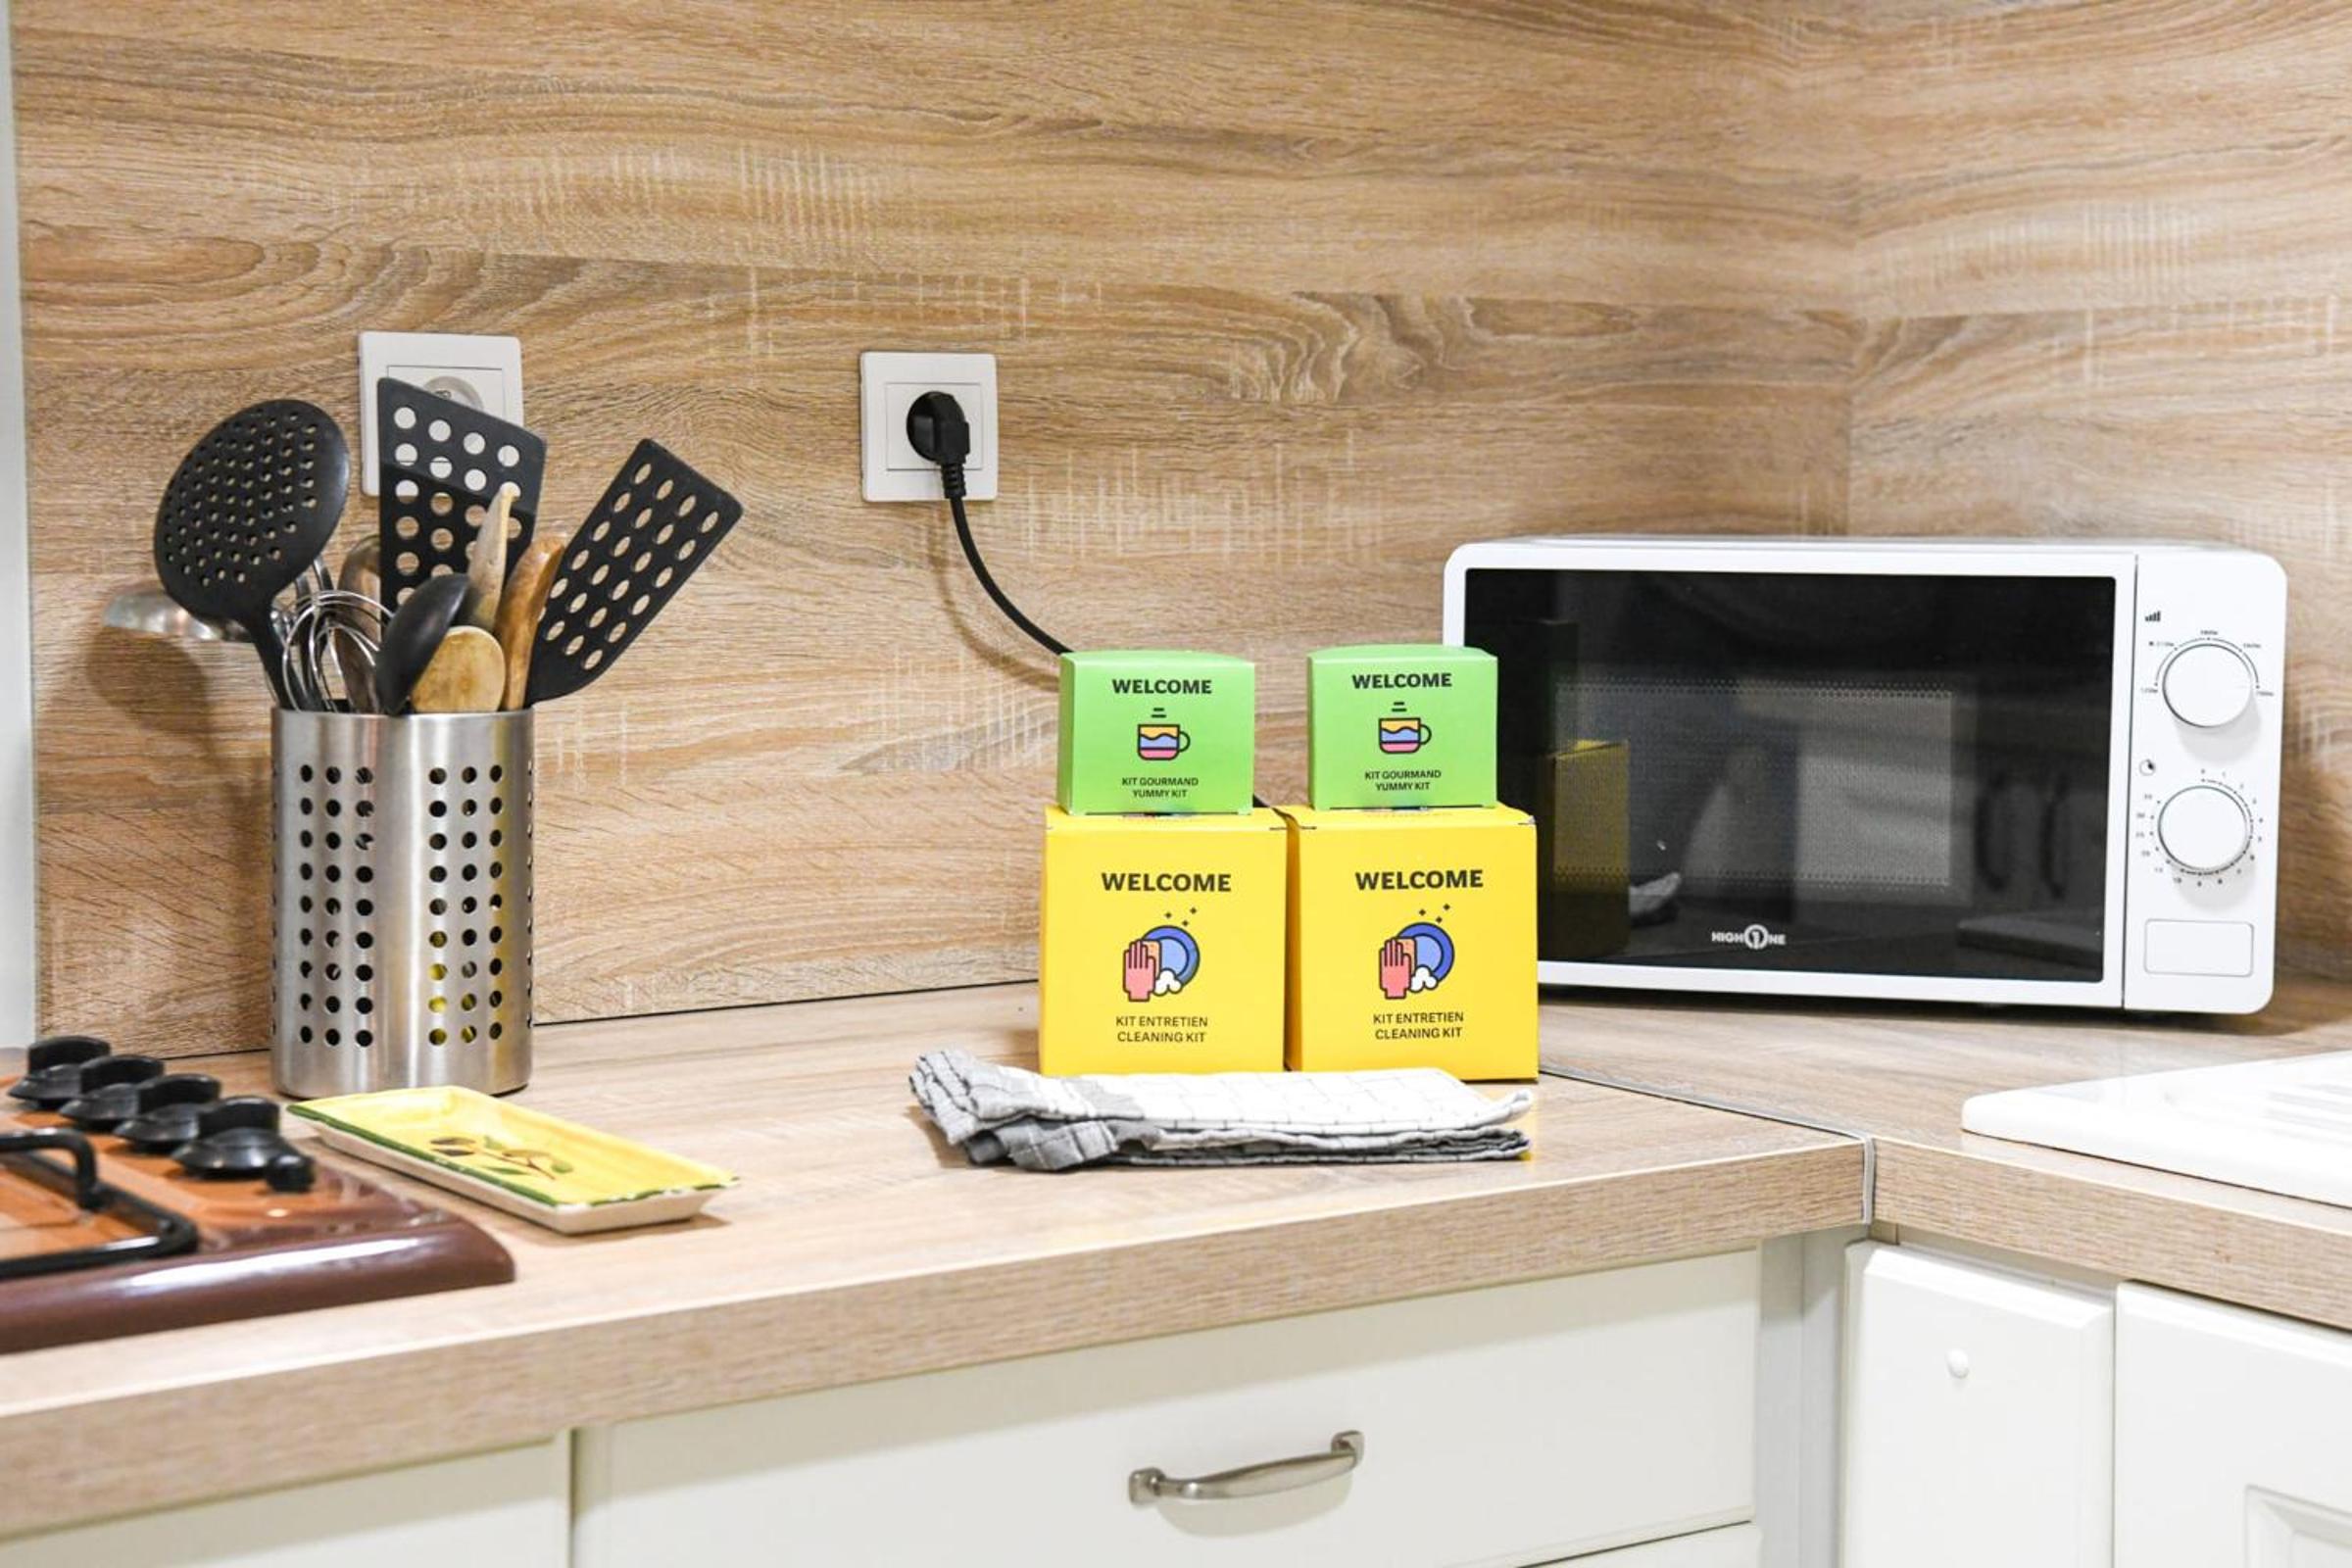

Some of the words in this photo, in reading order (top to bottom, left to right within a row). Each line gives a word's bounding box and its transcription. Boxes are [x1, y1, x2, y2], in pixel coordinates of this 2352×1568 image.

[1111, 678, 1212, 695] WELCOME
[1351, 672, 1452, 690] WELCOME
[1364, 770, 1381, 780] KIT
[1382, 769, 1443, 780] GOURMAND
[1121, 776, 1138, 787] KIT
[1139, 776, 1200, 787] GOURMAND
[1375, 782, 1413, 791] YUMMY
[1414, 781, 1431, 791] KIT
[1132, 788, 1170, 799] YUMMY
[1171, 788, 1188, 798] KIT
[1102, 872, 1232, 893] WELCOME
[1355, 868, 1484, 891] WELCOME
[1115, 1015, 1136, 1027] KIT
[1139, 1015, 1208, 1028] ENTRETIEN
[1373, 1013, 1394, 1025] KIT
[1396, 1011, 1464, 1024] ENTRETIEN
[1117, 1032, 1184, 1043] CLEANING
[1185, 1032, 1205, 1043] KIT
[1374, 1027, 1441, 1040] CLEANING
[1442, 1026, 1462, 1038] KIT
